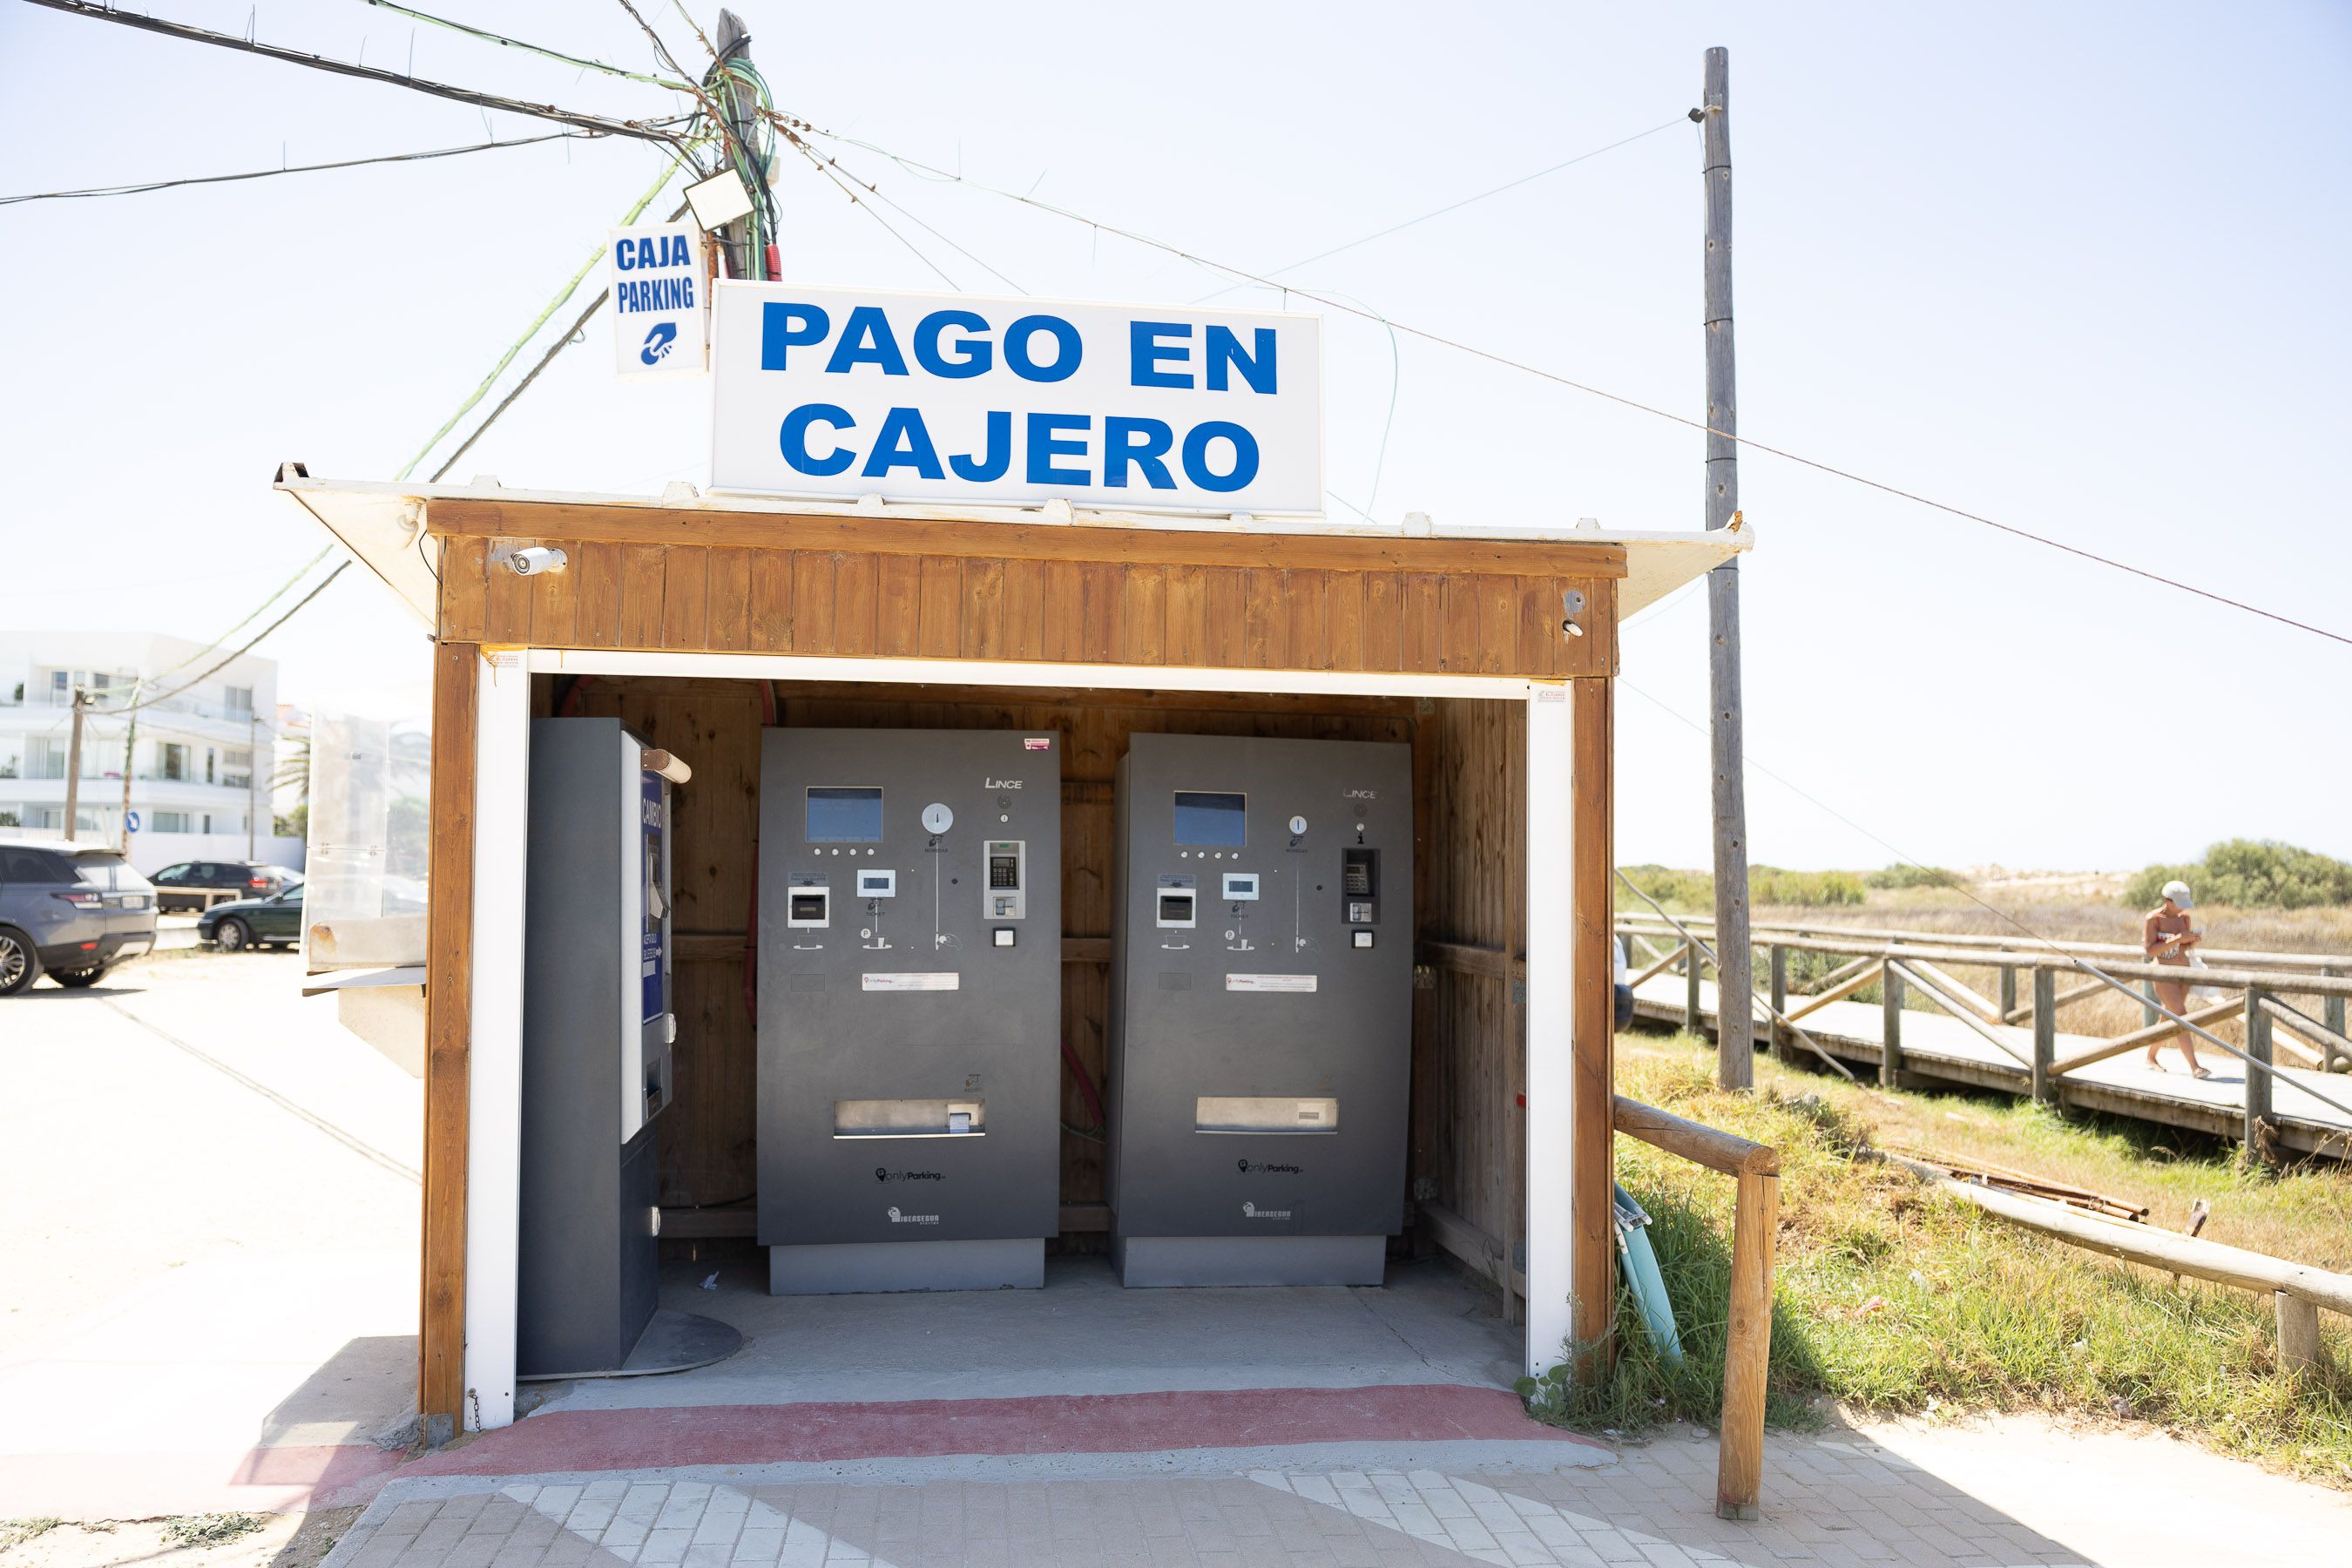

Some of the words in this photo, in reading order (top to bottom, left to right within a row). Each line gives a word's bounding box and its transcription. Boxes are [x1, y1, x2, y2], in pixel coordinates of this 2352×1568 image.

[616, 235, 691, 271] CAJA
[617, 277, 695, 314] PARKING
[760, 301, 1083, 383] PAGO
[1130, 321, 1278, 395] EN
[779, 402, 1260, 493] CAJERO
